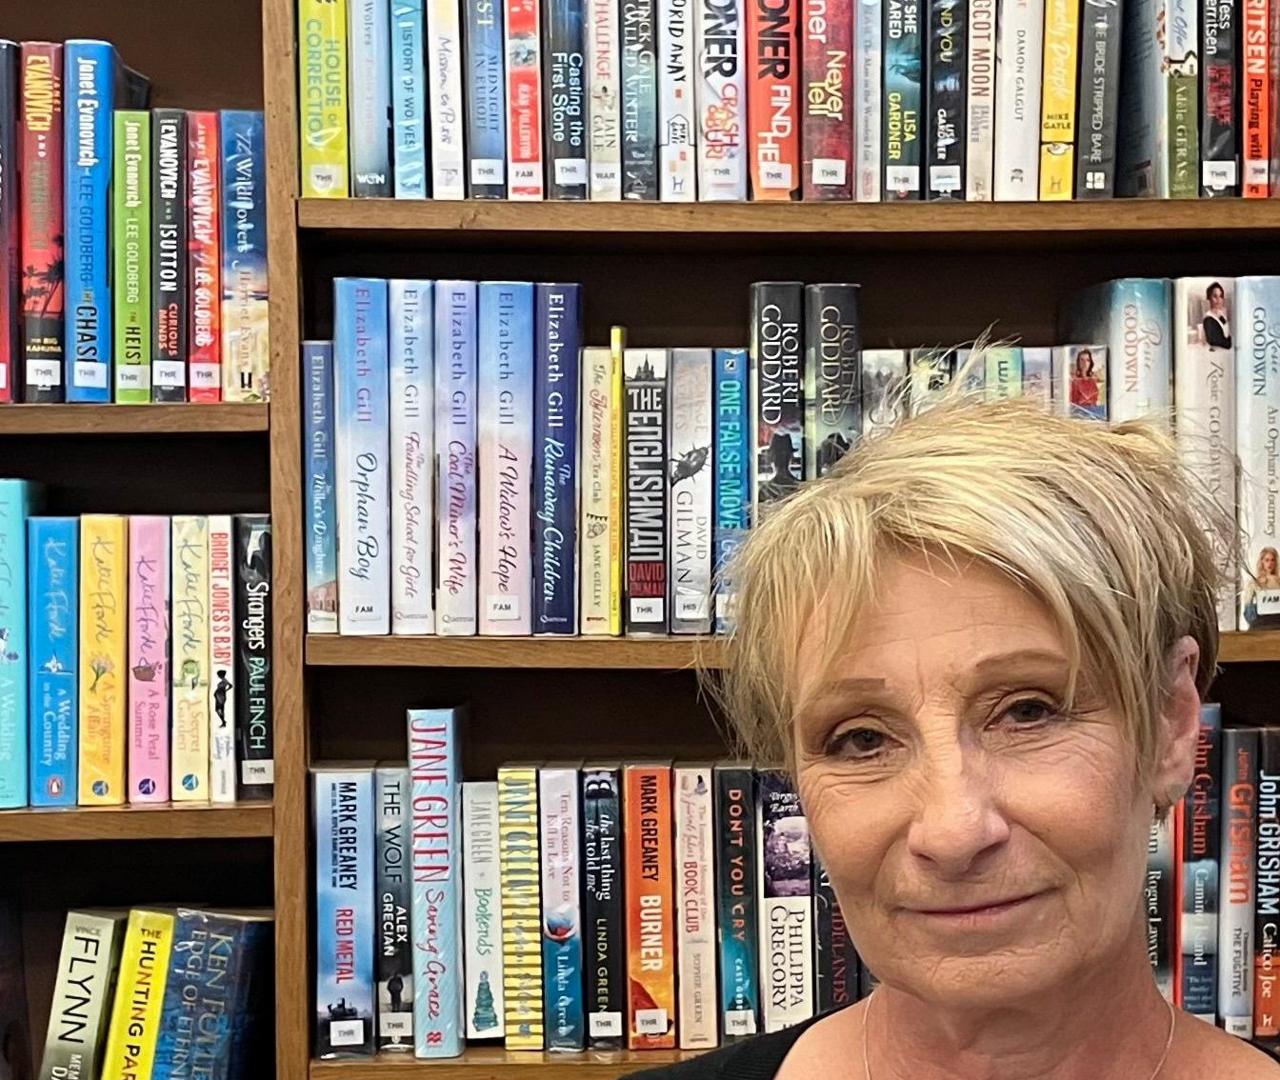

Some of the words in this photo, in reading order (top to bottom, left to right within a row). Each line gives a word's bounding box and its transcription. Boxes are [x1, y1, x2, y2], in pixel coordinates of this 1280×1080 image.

[552, 52, 567, 89] First
[568, 52, 581, 116] Casting
[825, 51, 844, 119] Never
[553, 93, 567, 142] Stone
[569, 121, 581, 145] the
[888, 93, 901, 160] GARDNER
[904, 111, 916, 142] LISA
[549, 293, 564, 384] Elizabeth
[762, 304, 781, 424] GODDARD
[782, 323, 798, 407] ROBERT
[549, 392, 564, 428] Gill
[629, 389, 662, 409] THE
[350, 452, 377, 533] Orphan
[350, 535, 380, 582] Boy
[356, 605, 373, 613] FAM
[249, 657, 265, 695] PAUL
[249, 699, 266, 749] FINCH
[411, 719, 448, 789] JANE
[339, 782, 356, 822] MARK
[1259, 770, 1280, 816] John
[339, 827, 357, 891] GREANEY
[413, 795, 449, 883] GREEN
[1259, 817, 1280, 915] GRISHAM
[336, 907, 352, 937] RED
[382, 892, 394, 957] GRECIAN
[396, 906, 408, 943] ALEX
[639, 894, 663, 972] BURNER
[58, 936, 99, 1044] FLYNN
[128, 941, 156, 1038] HUNTING
[336, 940, 354, 984] METAL
